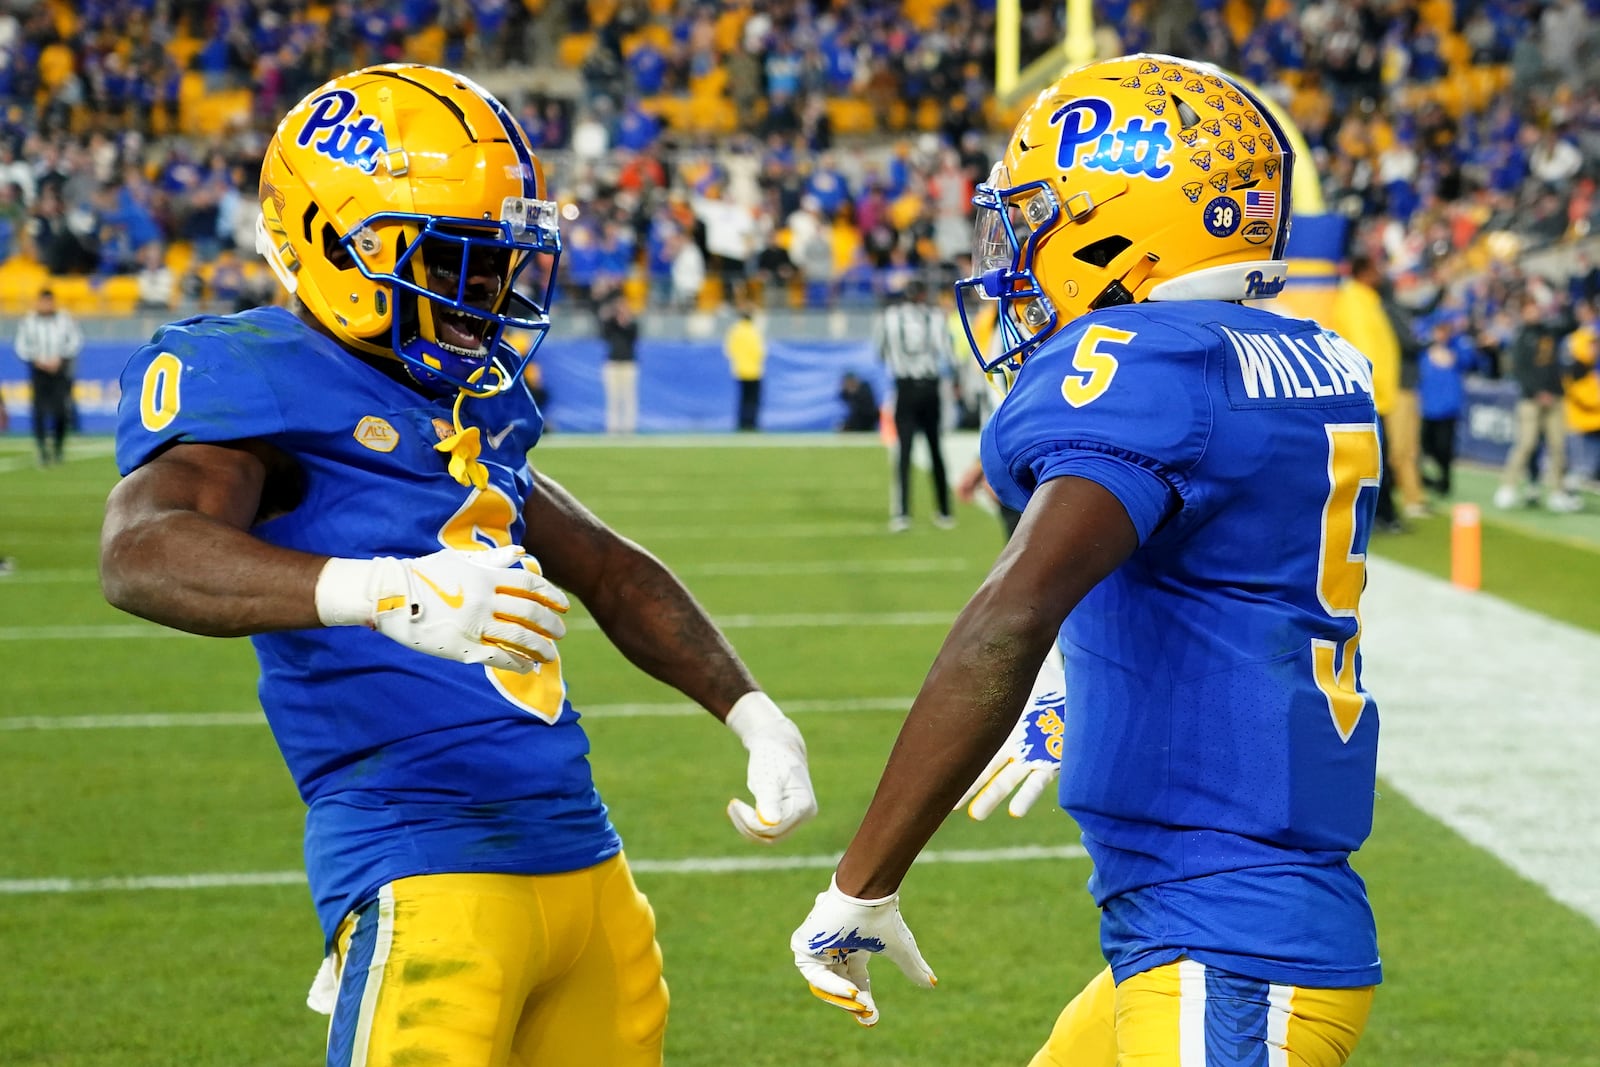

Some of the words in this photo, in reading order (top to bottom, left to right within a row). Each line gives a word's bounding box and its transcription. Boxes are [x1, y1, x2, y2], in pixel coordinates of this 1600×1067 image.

[296, 89, 388, 175] Pitt
[1048, 97, 1173, 181] Pitt
[1212, 206, 1234, 228] 38
[1246, 226, 1269, 236] ACC
[140, 352, 182, 432] 0
[1061, 324, 1138, 408] 5
[1220, 325, 1375, 399] WILLIA
[1311, 423, 1381, 744] 5
